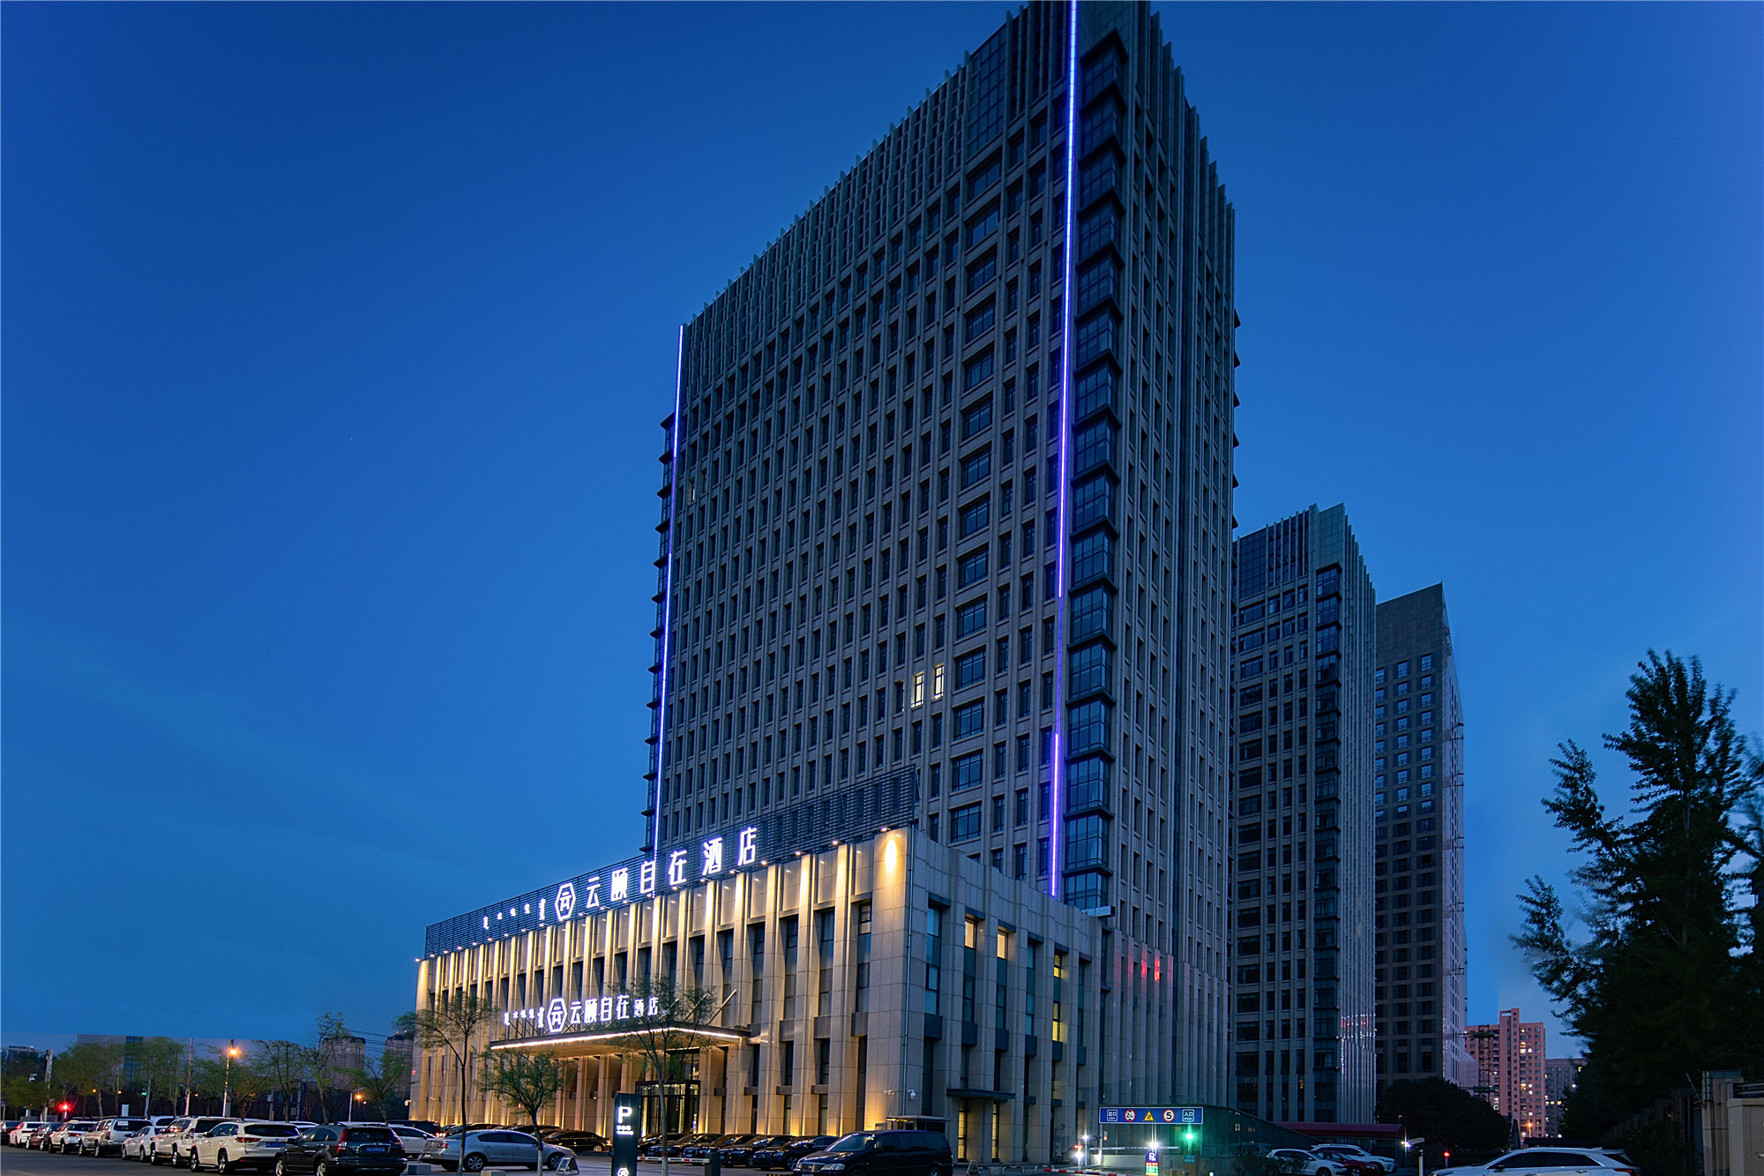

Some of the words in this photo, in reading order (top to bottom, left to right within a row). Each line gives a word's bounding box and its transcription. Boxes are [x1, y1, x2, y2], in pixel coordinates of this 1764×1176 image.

[586, 826, 757, 908] 云颐自在酒店
[617, 1106, 632, 1124] P
